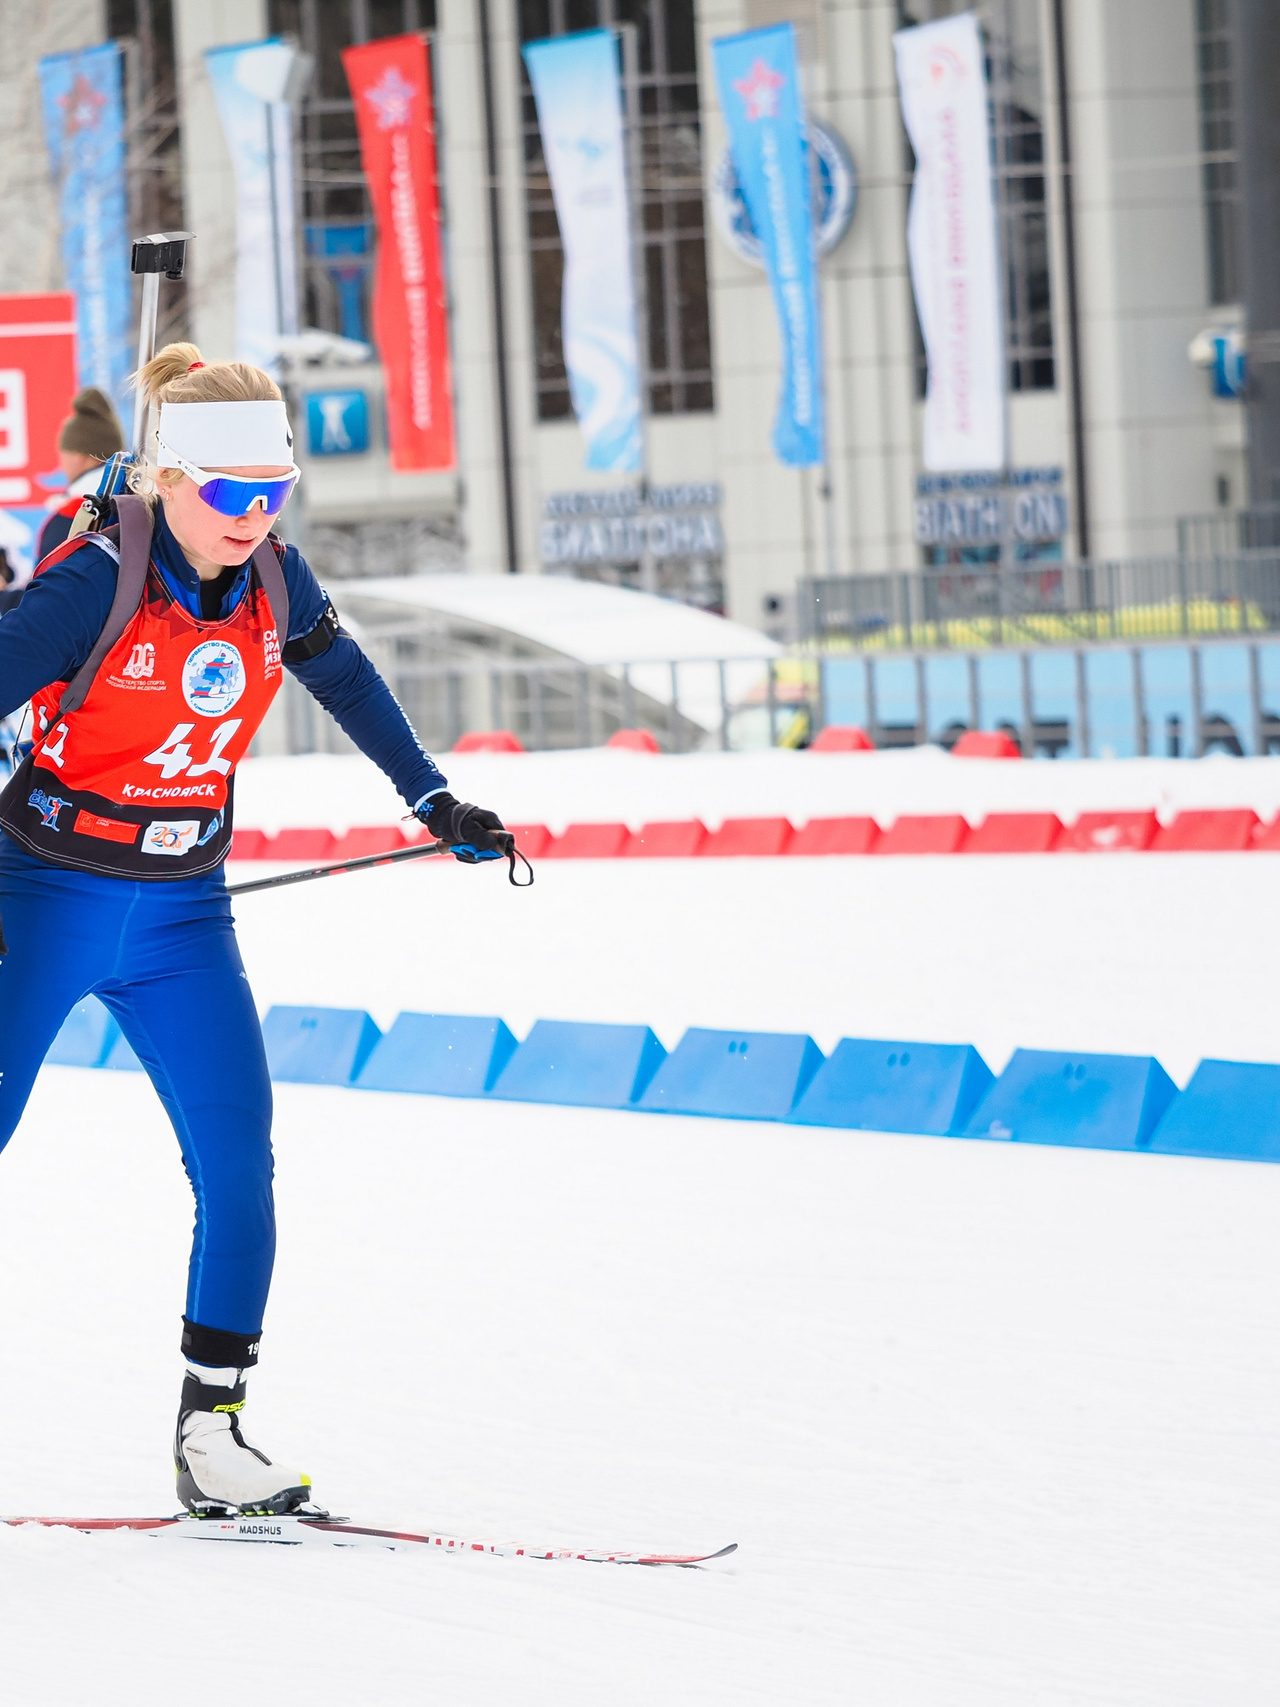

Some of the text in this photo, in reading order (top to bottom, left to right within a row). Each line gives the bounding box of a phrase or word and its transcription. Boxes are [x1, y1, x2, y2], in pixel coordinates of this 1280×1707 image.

[142, 718, 243, 779] 41
[121, 783, 218, 799] КРАСНОЯРСК
[212, 1399, 246, 1413] FISC
[239, 1525, 281, 1535] MADSHUS
